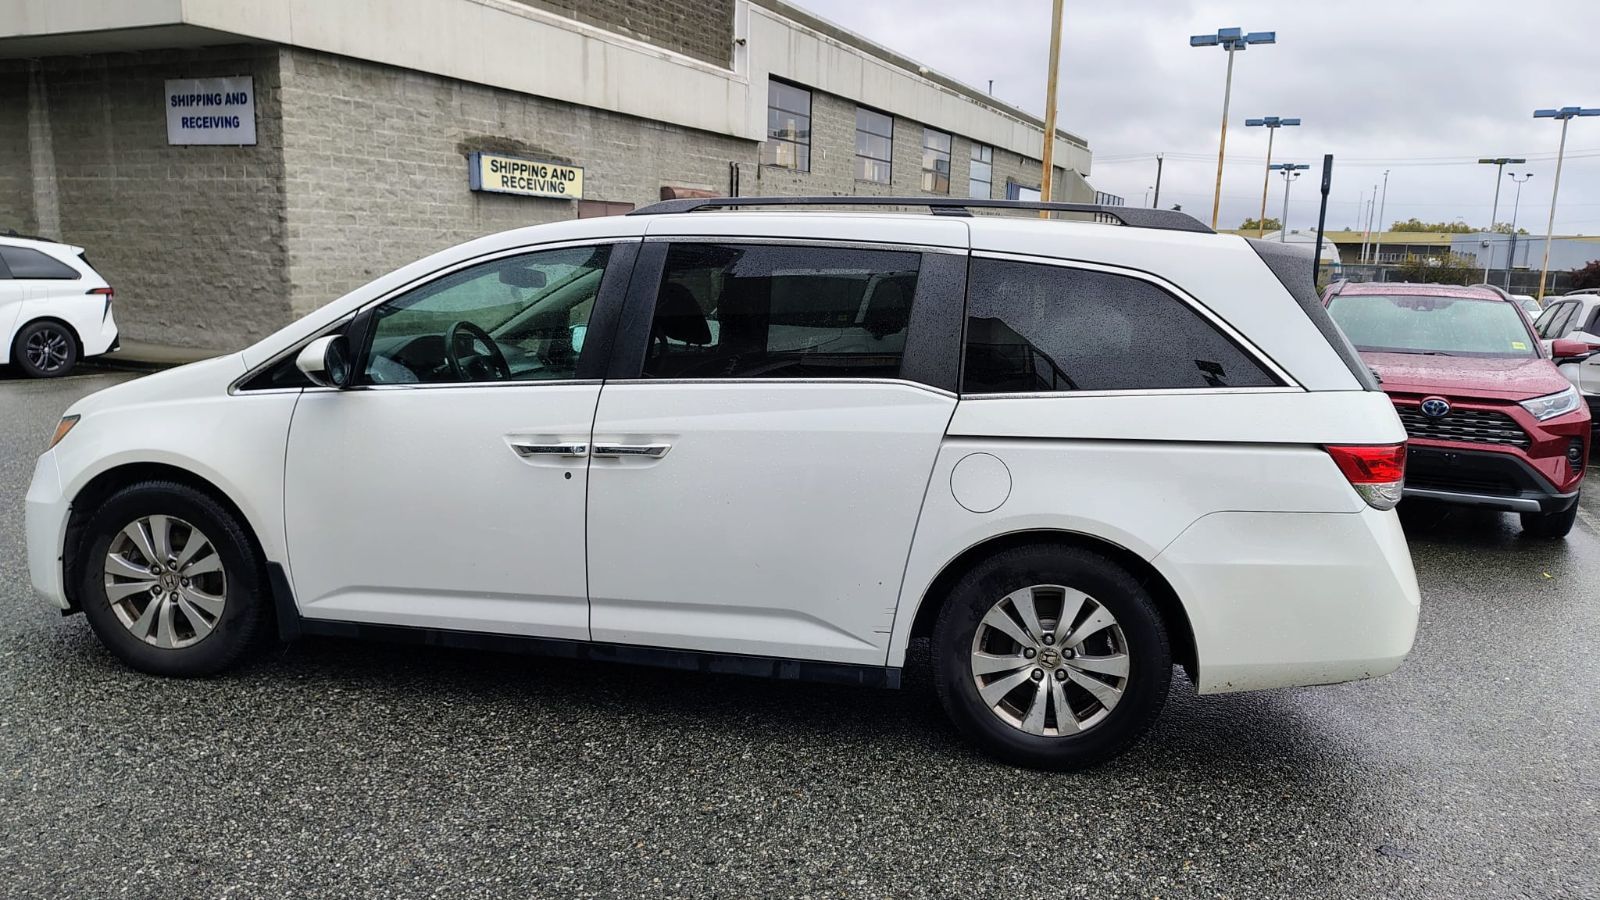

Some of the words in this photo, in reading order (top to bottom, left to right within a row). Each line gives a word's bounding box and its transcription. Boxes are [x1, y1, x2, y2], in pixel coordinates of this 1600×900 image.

[170, 93, 222, 107] SHIPPING
[224, 92, 248, 105] AND
[181, 116, 240, 129] RECEIVING
[490, 159, 548, 178] SHIPPING
[550, 167, 576, 182] AND
[501, 175, 565, 193] RECEIVING
